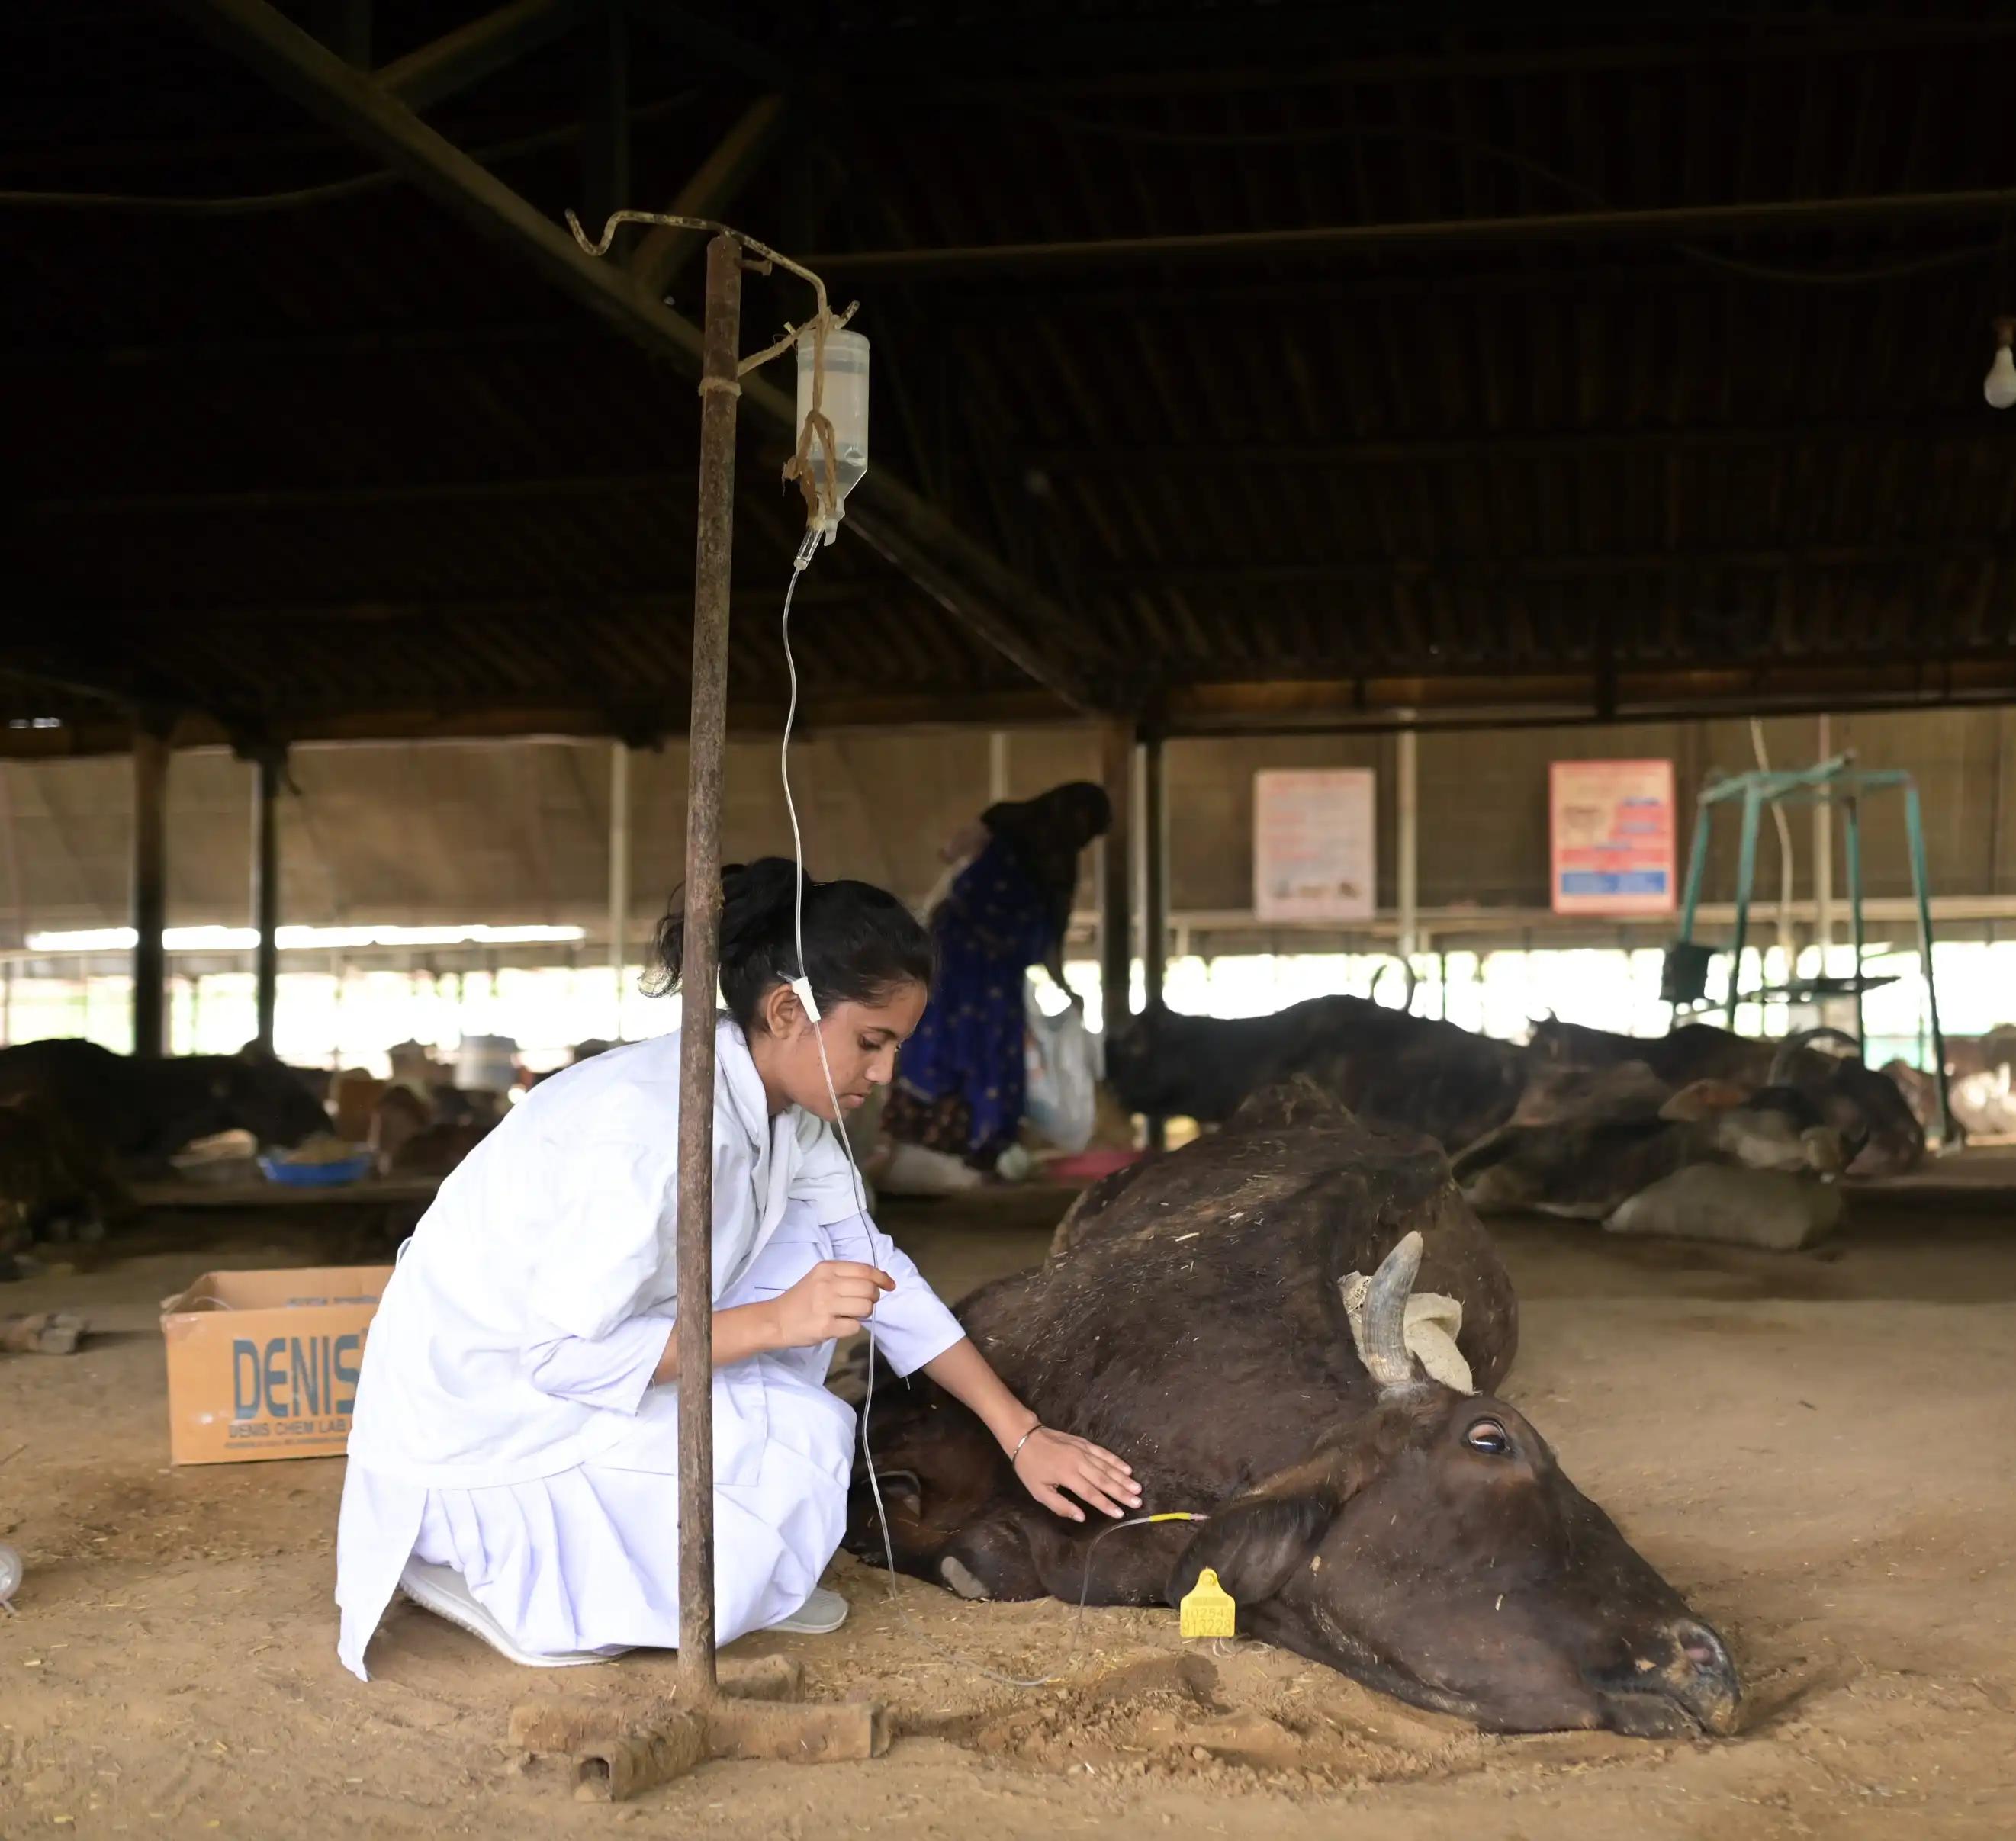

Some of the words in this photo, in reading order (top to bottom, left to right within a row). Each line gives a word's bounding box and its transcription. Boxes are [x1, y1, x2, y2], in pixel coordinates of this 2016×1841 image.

[233, 1335, 360, 1419] DENIS
[229, 1423, 270, 1438] DENIS
[276, 1420, 313, 1435] CHEM
[320, 1418, 346, 1431] LAB
